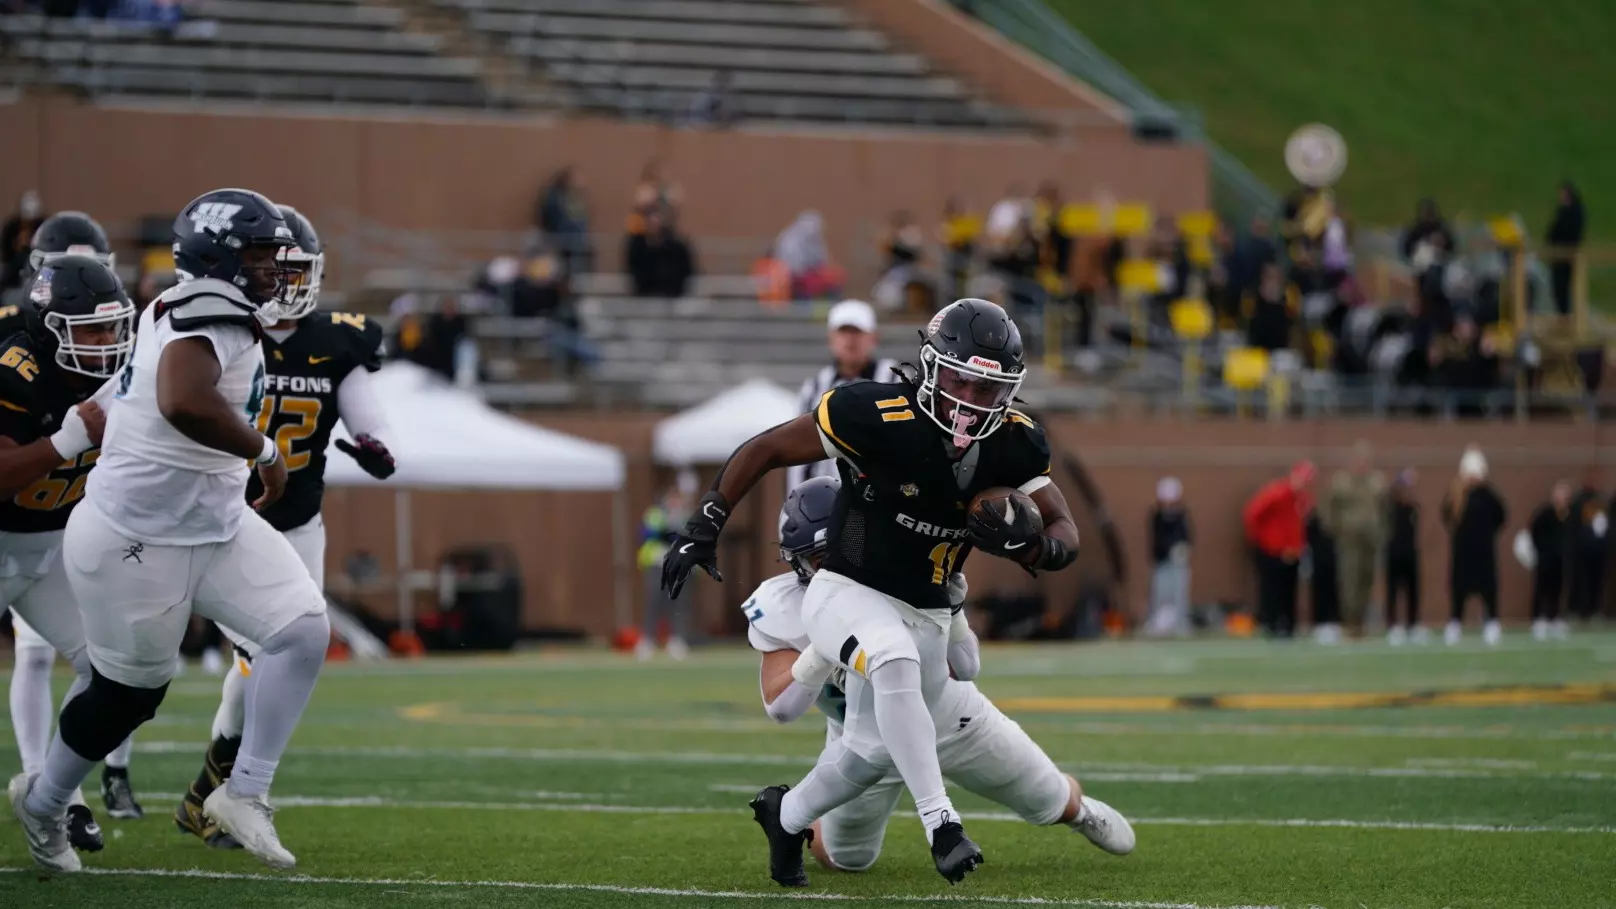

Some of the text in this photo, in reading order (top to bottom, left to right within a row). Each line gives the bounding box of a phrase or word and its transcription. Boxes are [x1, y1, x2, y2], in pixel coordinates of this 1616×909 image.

[0, 346, 40, 382] 62
[972, 357, 1000, 370] Riddell
[265, 374, 332, 393] FFONS
[875, 396, 915, 422] 11
[895, 512, 970, 540] GRIFFO
